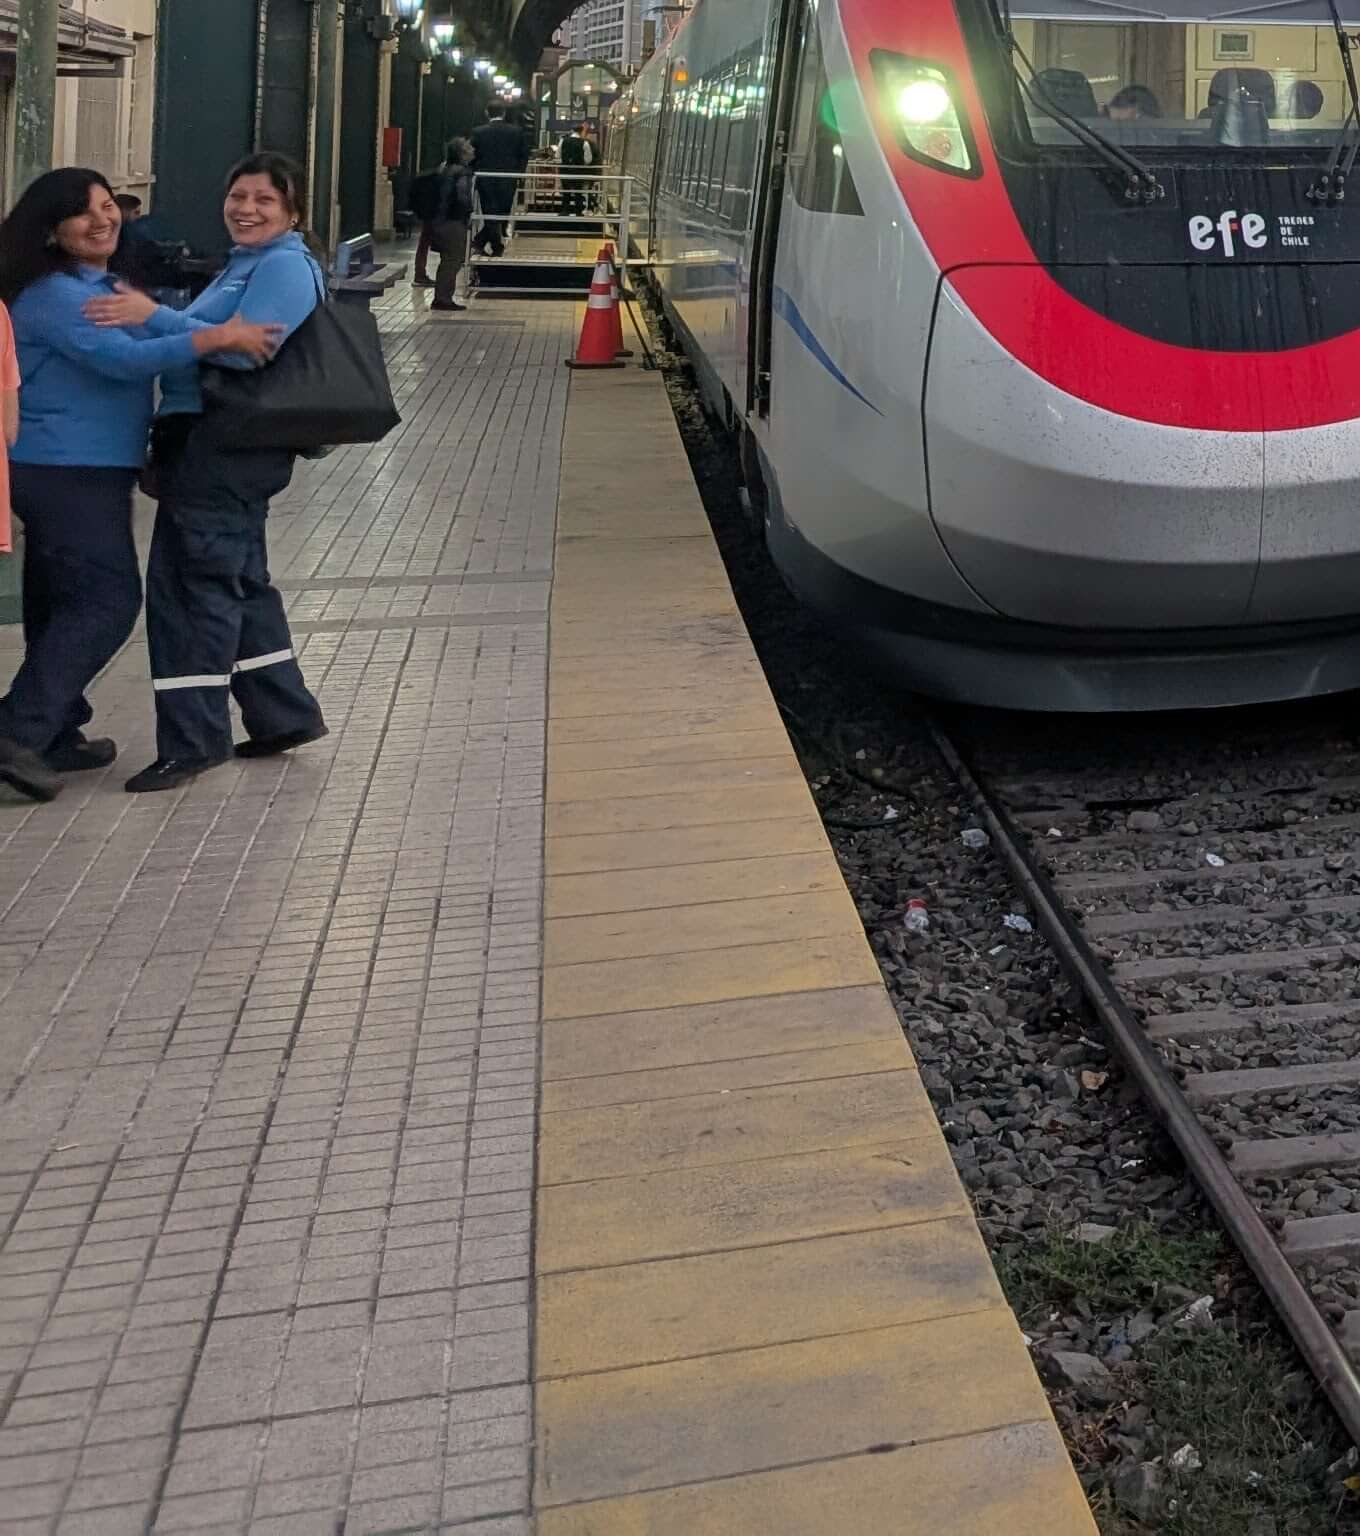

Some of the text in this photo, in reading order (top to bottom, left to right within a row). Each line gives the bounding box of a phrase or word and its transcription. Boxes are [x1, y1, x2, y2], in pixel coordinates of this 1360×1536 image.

[1278, 216, 1315, 226] TRENES
[1188, 210, 1268, 257] efe
[1280, 226, 1293, 236] DE
[1281, 236, 1310, 246] CHILE
